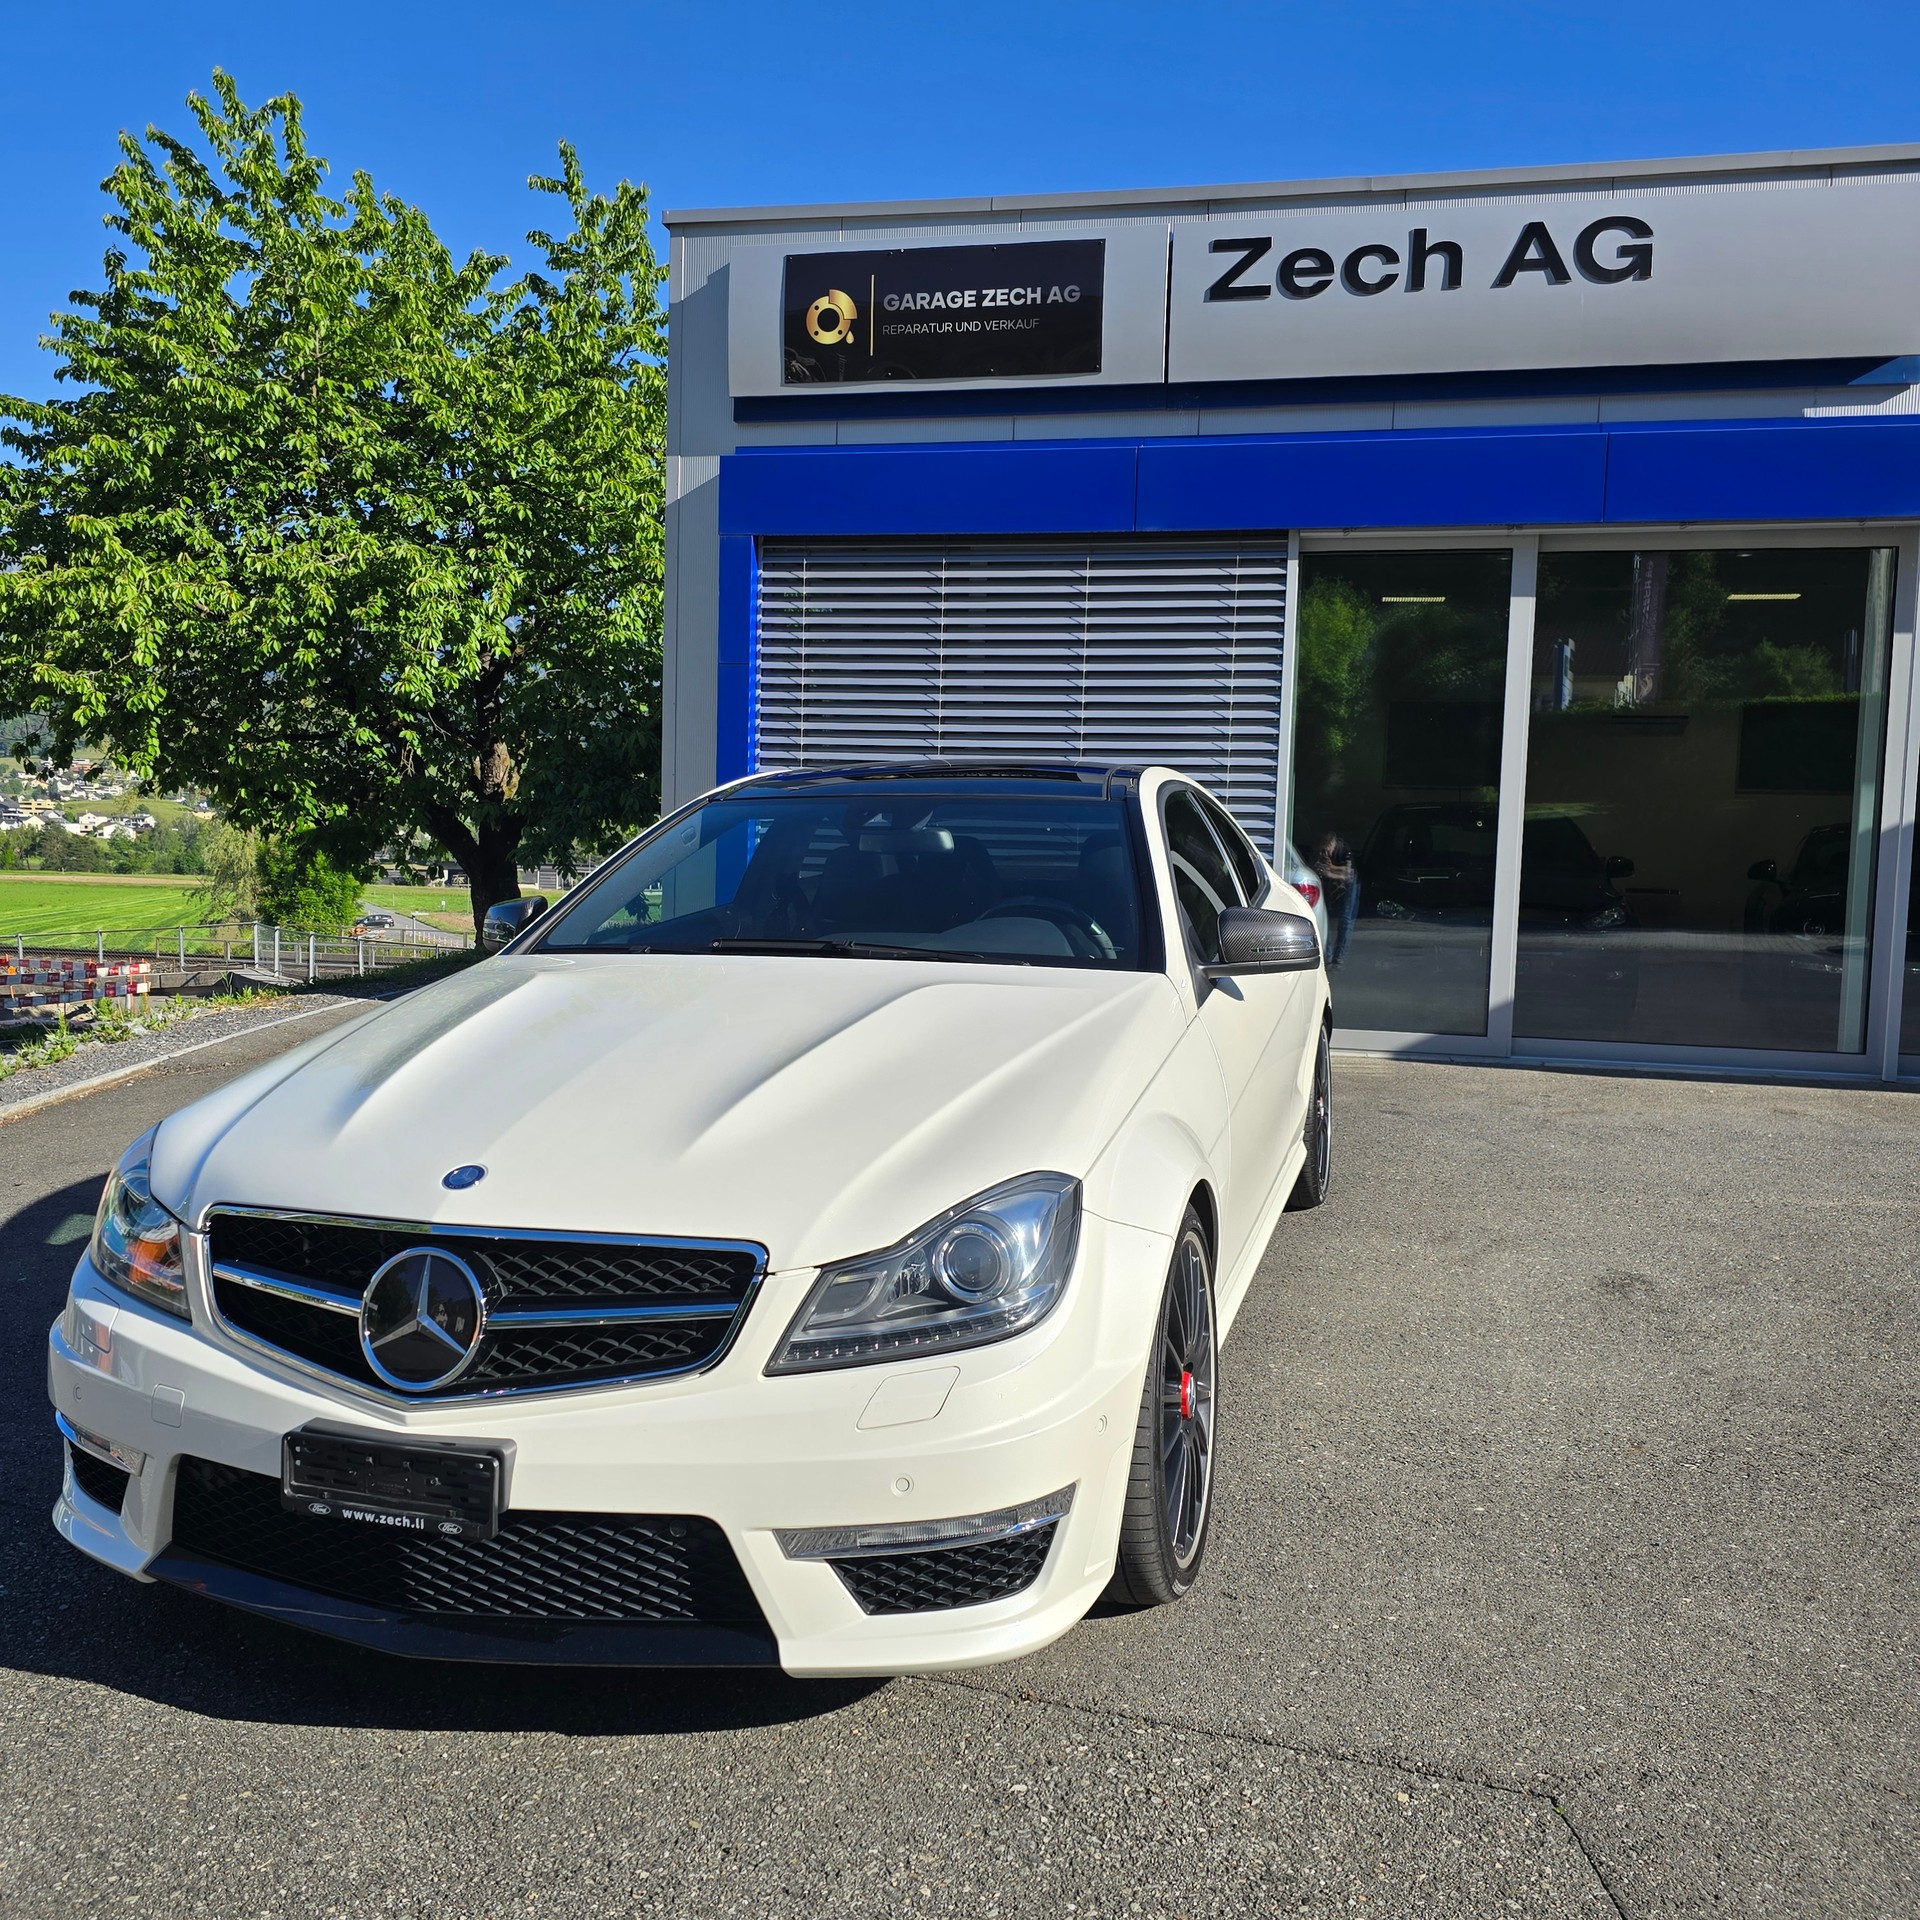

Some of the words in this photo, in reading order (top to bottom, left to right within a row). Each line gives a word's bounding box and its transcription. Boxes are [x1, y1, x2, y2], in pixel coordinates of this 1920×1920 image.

[1204, 227, 1463, 302] Zech
[1490, 216, 1654, 290] AG
[883, 289, 977, 312] GARAGE
[981, 287, 1042, 307] ZECH
[1046, 285, 1081, 304] AG
[882, 321, 953, 336] REPARATUR
[955, 320, 982, 334] UND
[984, 318, 1041, 332] VERKAUF
[342, 1509, 425, 1530] www.zech.li
